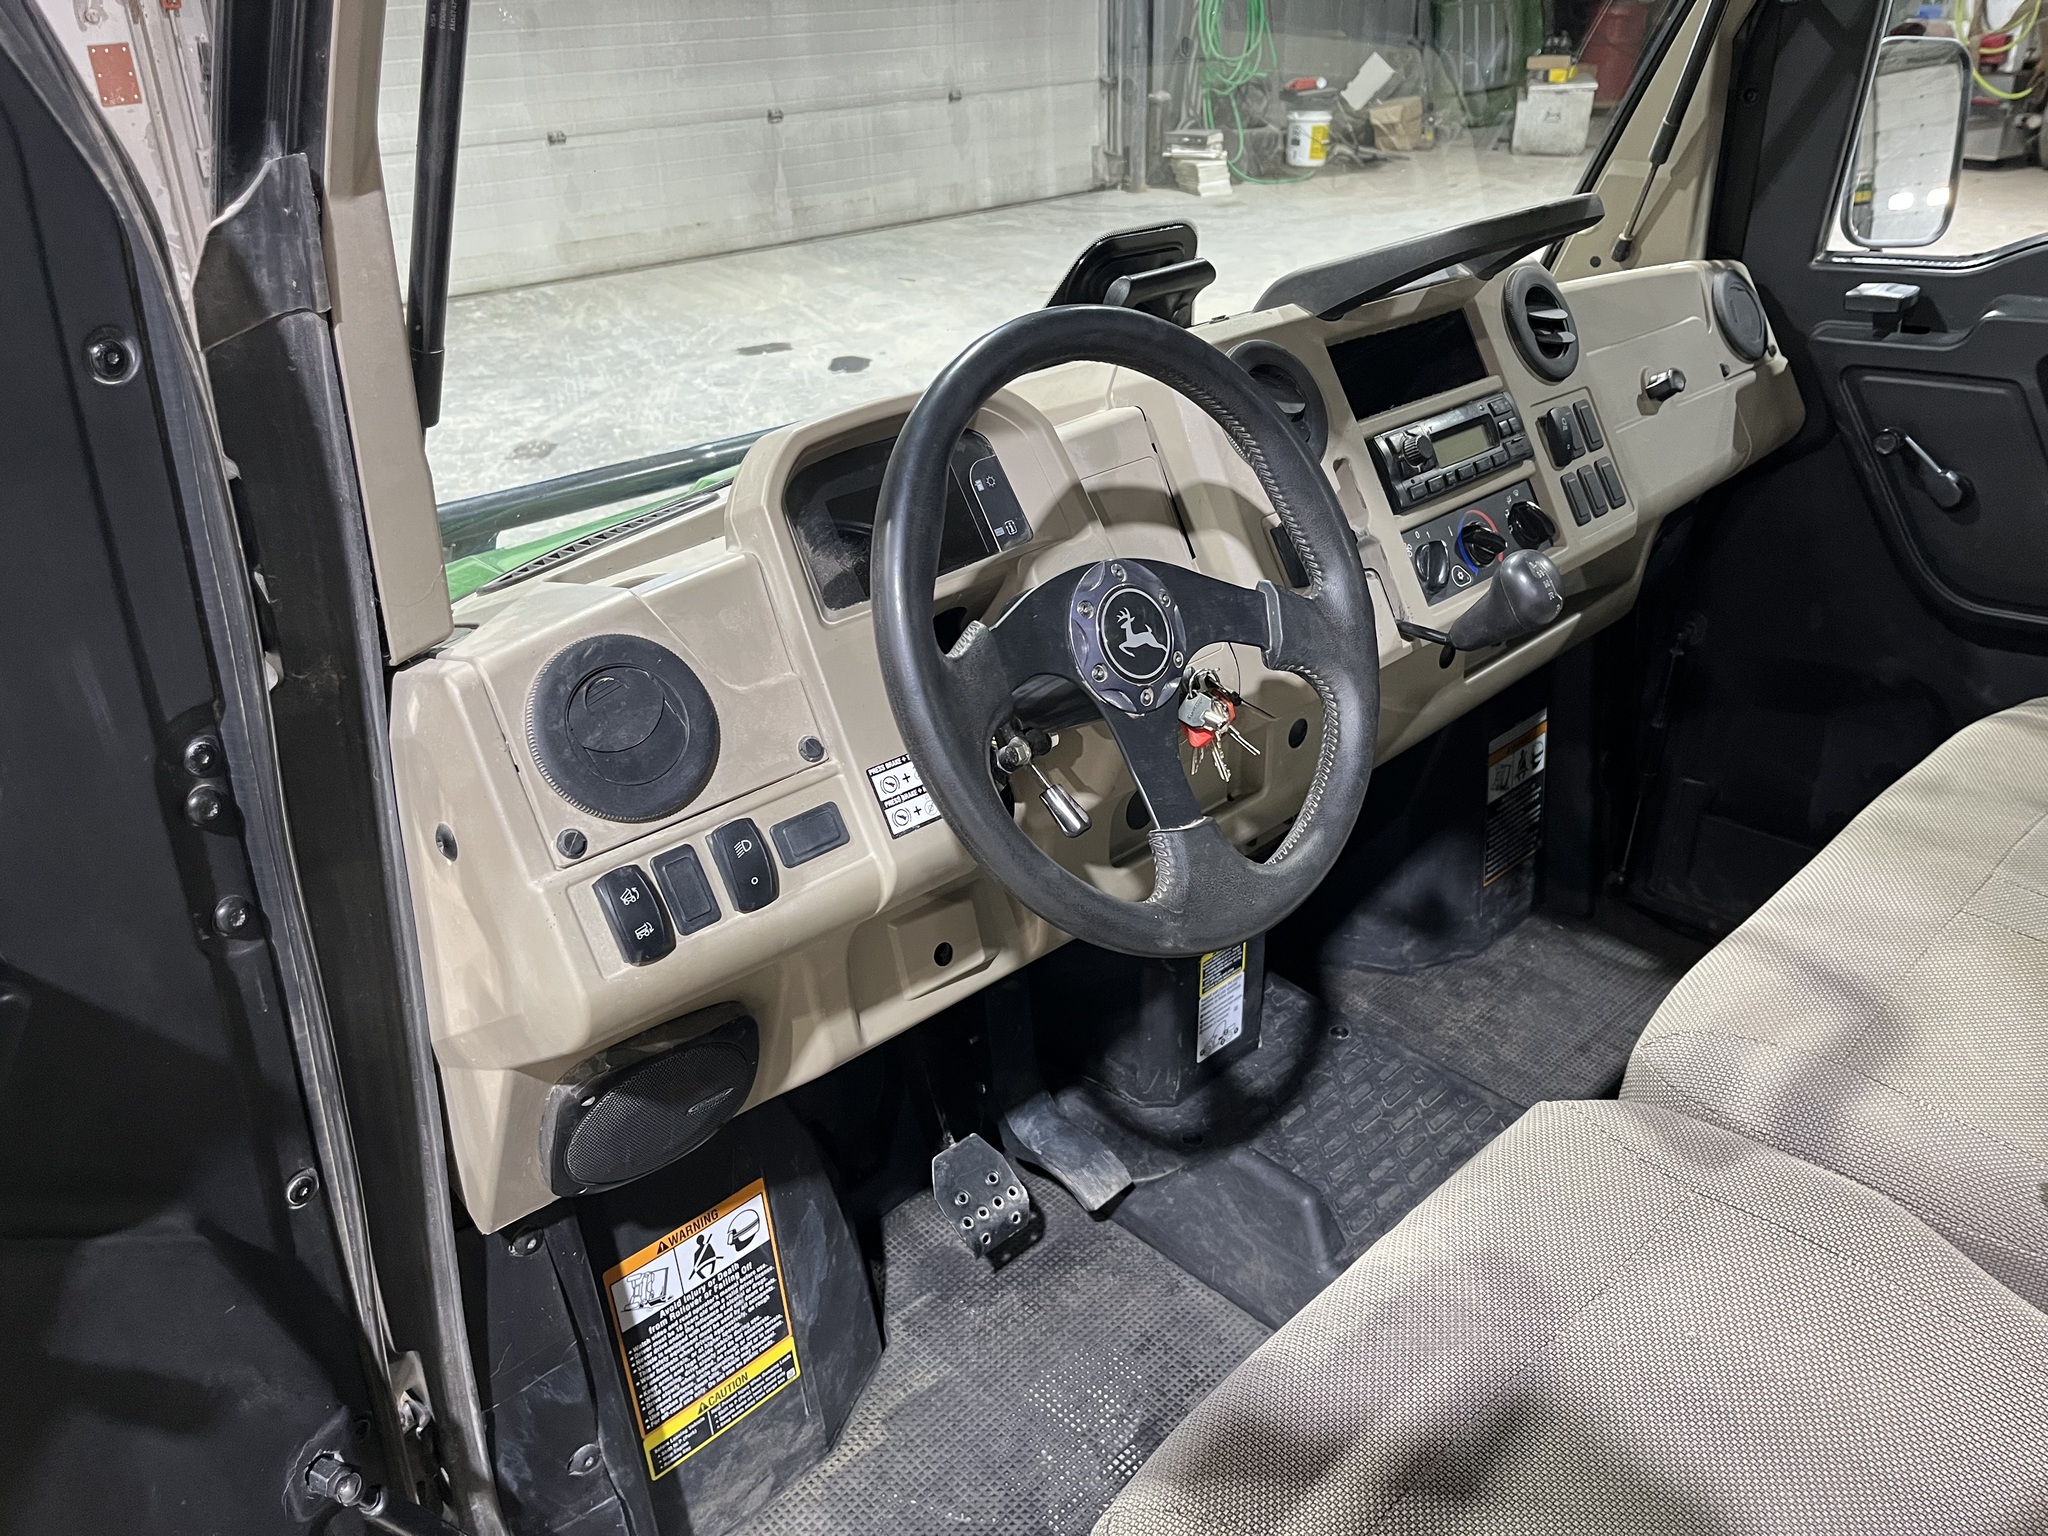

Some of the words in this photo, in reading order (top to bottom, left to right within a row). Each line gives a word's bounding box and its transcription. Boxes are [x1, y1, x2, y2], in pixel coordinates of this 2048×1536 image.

[868, 764, 886, 776] PRESS
[885, 758, 902, 769] BRAKE
[884, 796, 902, 808] PRESS
[901, 789, 918, 801] BRAKE
[668, 1209, 719, 1246] WARNING
[649, 1318, 668, 1334] from
[669, 1296, 702, 1321] Rollover
[704, 1289, 712, 1299] or
[714, 1272, 740, 1293] Falling
[741, 1262, 752, 1274] Off
[660, 1299, 682, 1319] Avoid
[683, 1284, 706, 1303] Injury
[708, 1278, 716, 1288] or
[717, 1263, 740, 1281] Death
[708, 1372, 748, 1406] CAUTION
